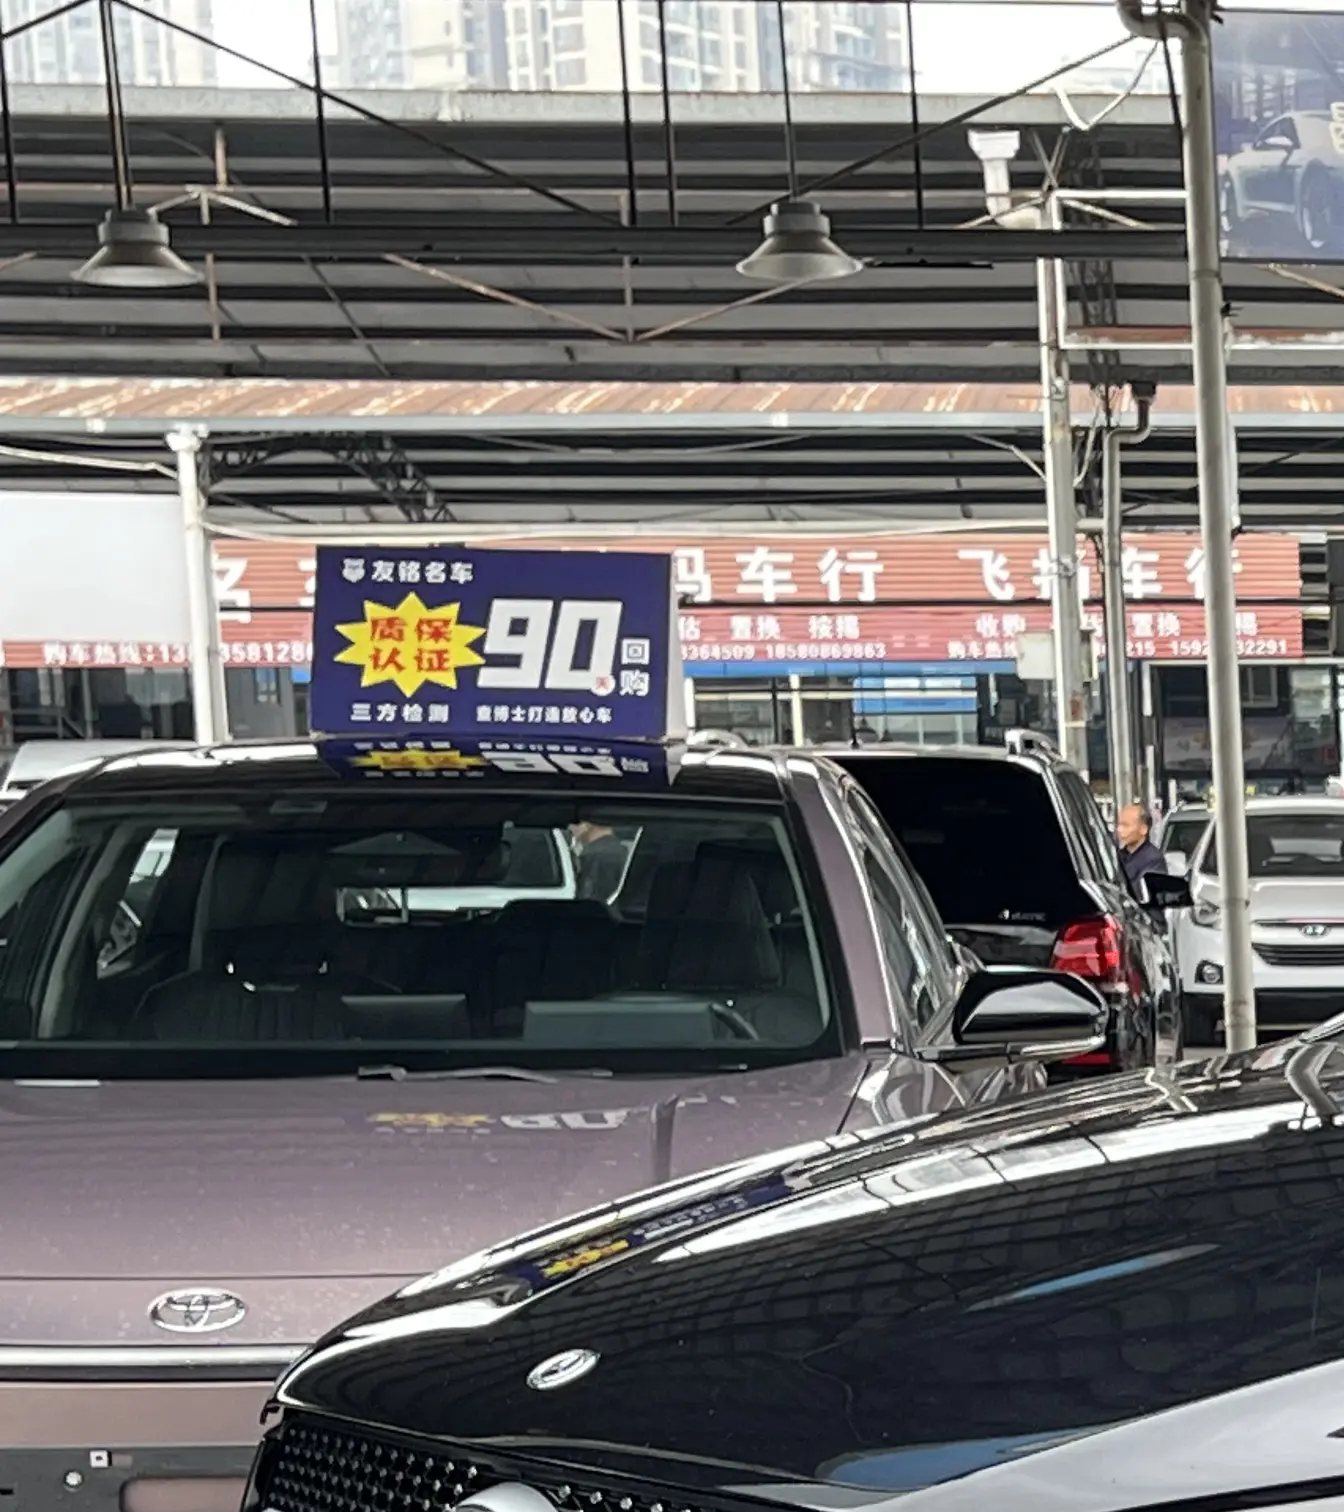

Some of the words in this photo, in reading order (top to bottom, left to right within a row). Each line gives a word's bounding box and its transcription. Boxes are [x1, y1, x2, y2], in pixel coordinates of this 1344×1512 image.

[370, 617, 453, 643] 质保
[477, 599, 623, 690] 90
[370, 647, 451, 673] 认证
[620, 638, 650, 697] 回购
[351, 703, 449, 723] 三方检测
